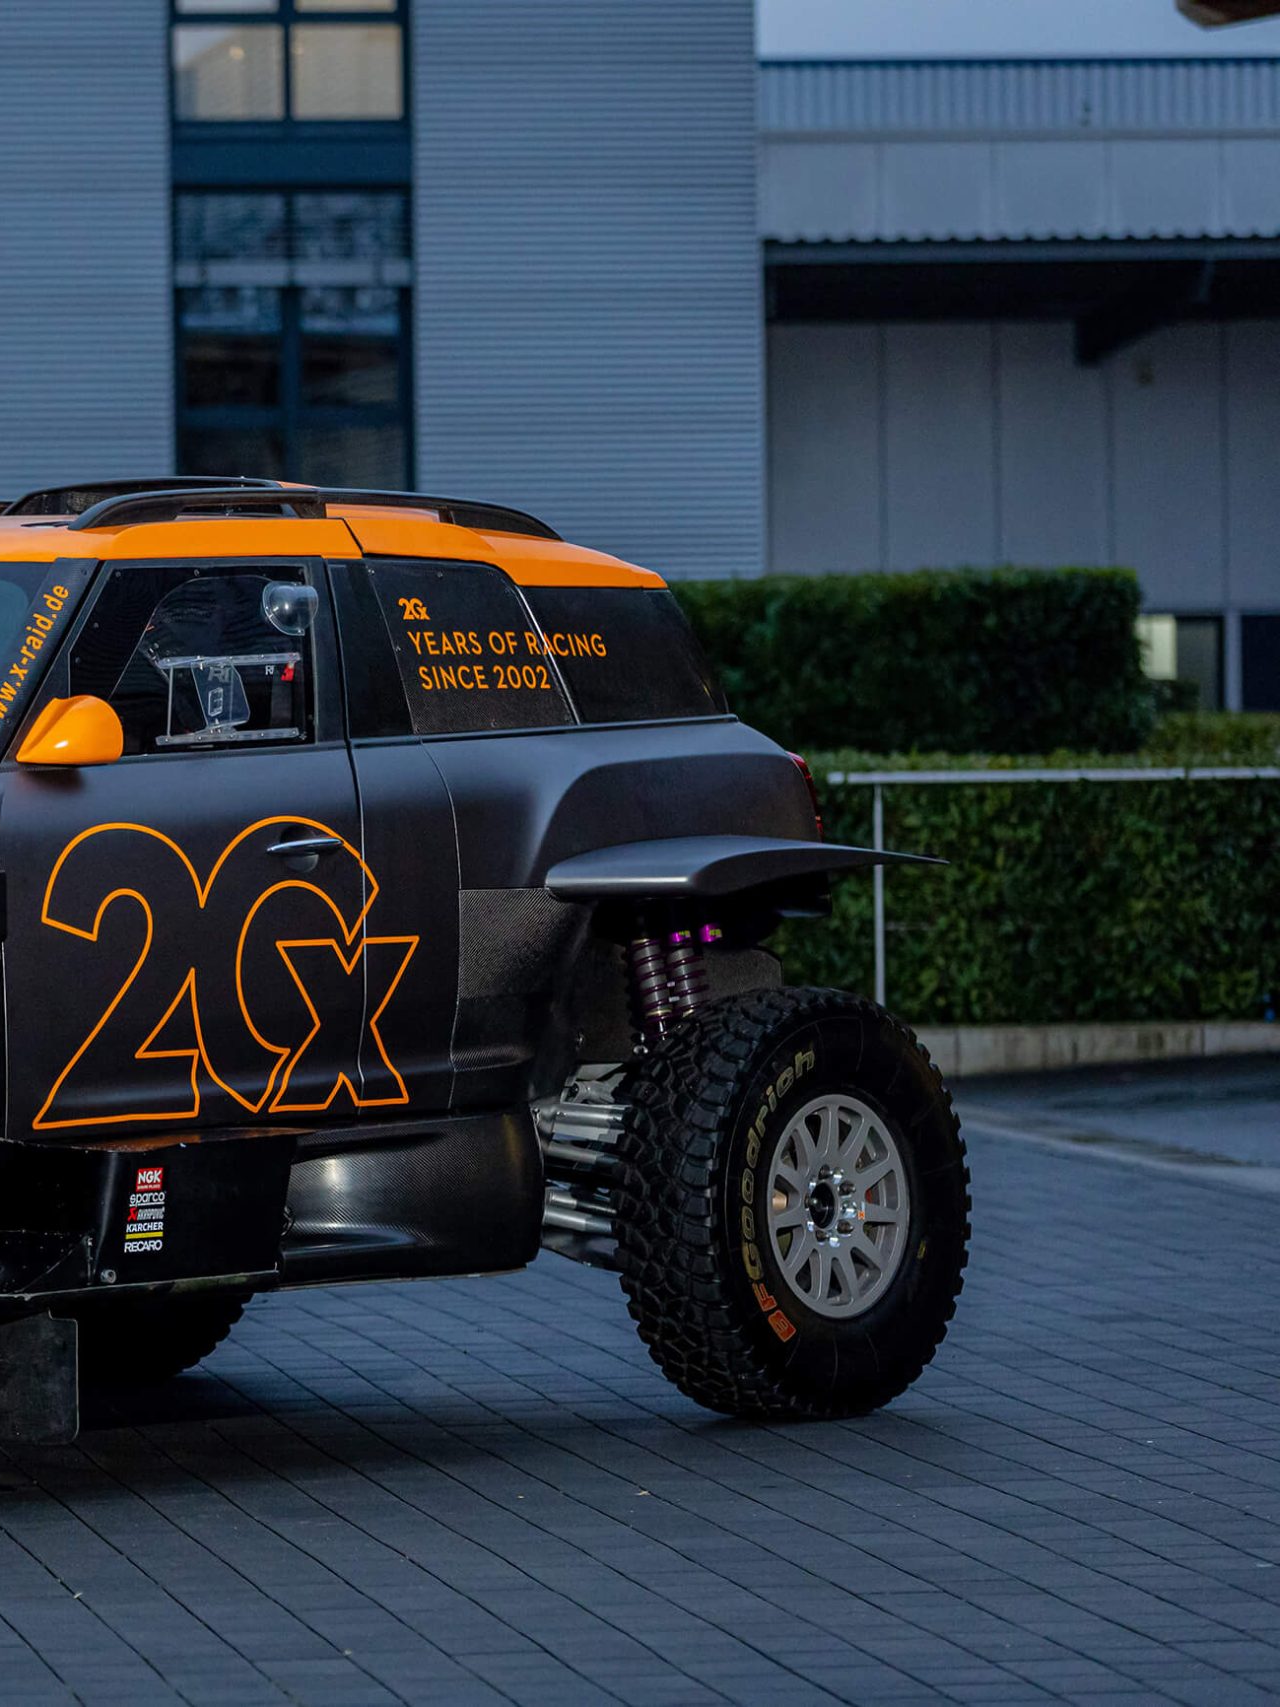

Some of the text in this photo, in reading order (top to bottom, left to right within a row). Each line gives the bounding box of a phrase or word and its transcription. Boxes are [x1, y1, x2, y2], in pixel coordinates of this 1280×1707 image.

[407, 631, 607, 657] YEARS OF RACING
[419, 665, 551, 690] SINCE 2002
[138, 1170, 161, 1185] NGK
[129, 1191, 165, 1207] sparco
[124, 1239, 163, 1253] RECARO
